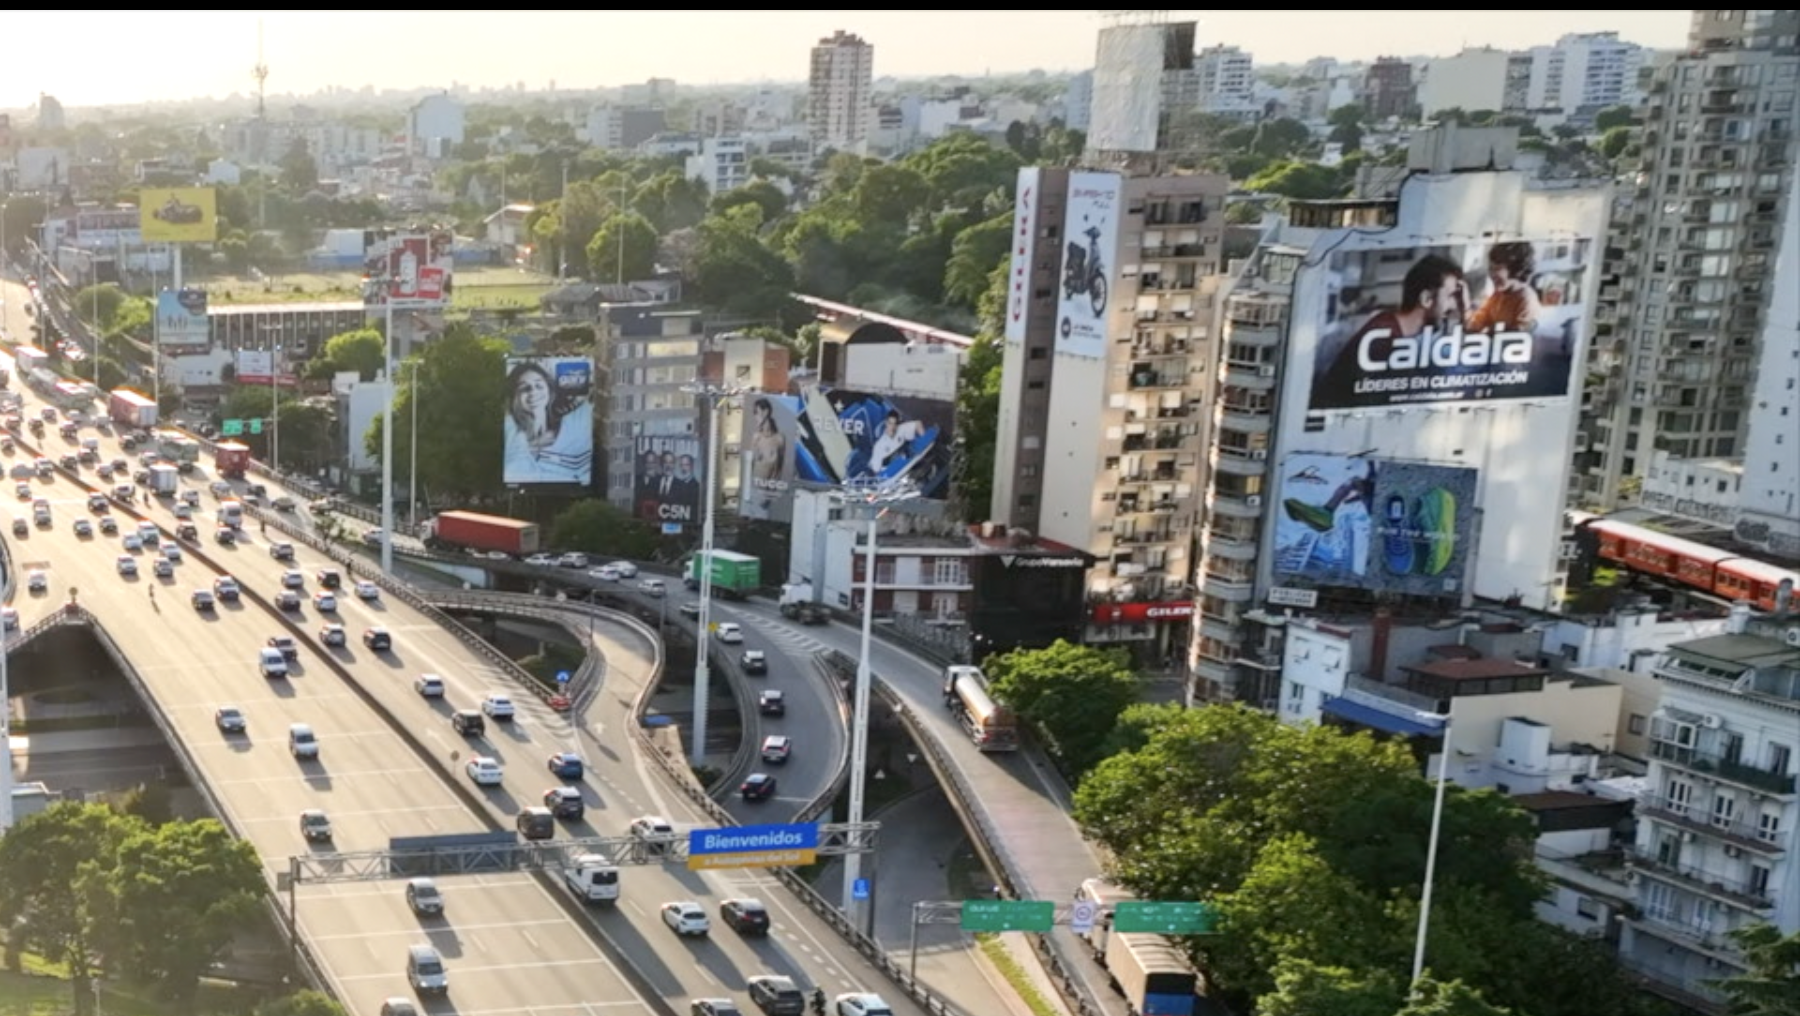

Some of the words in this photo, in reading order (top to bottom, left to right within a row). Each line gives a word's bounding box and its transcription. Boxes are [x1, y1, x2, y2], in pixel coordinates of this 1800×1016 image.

[1357, 322, 1533, 371] Caldaia
[1354, 375, 1409, 393] LÍDERES
[1410, 375, 1429, 390] EN
[1430, 369, 1529, 389] CLIMATIZACIÓN
[658, 503, 691, 520] C5N
[704, 830, 803, 849] Bienvenidos
